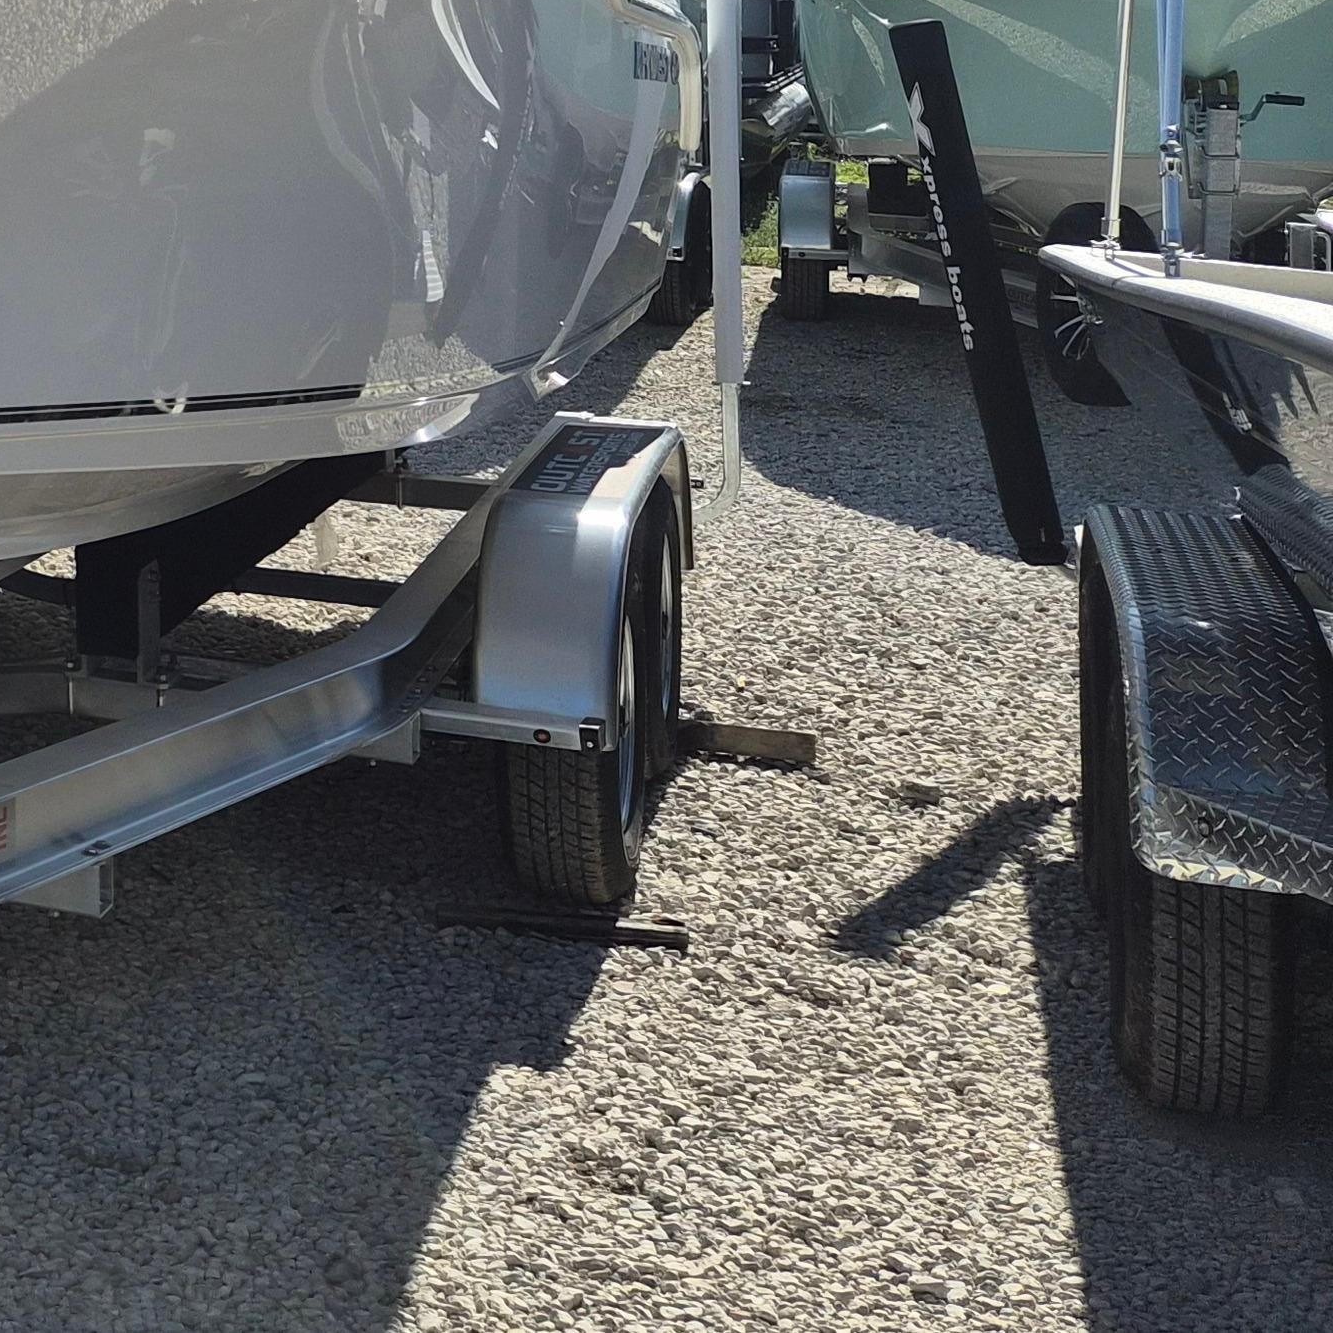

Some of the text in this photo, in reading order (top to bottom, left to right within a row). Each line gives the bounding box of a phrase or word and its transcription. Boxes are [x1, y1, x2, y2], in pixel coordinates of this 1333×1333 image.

[920, 156, 951, 258] xpress
[946, 266, 975, 351] boats
[531, 430, 605, 492] OUTCST
